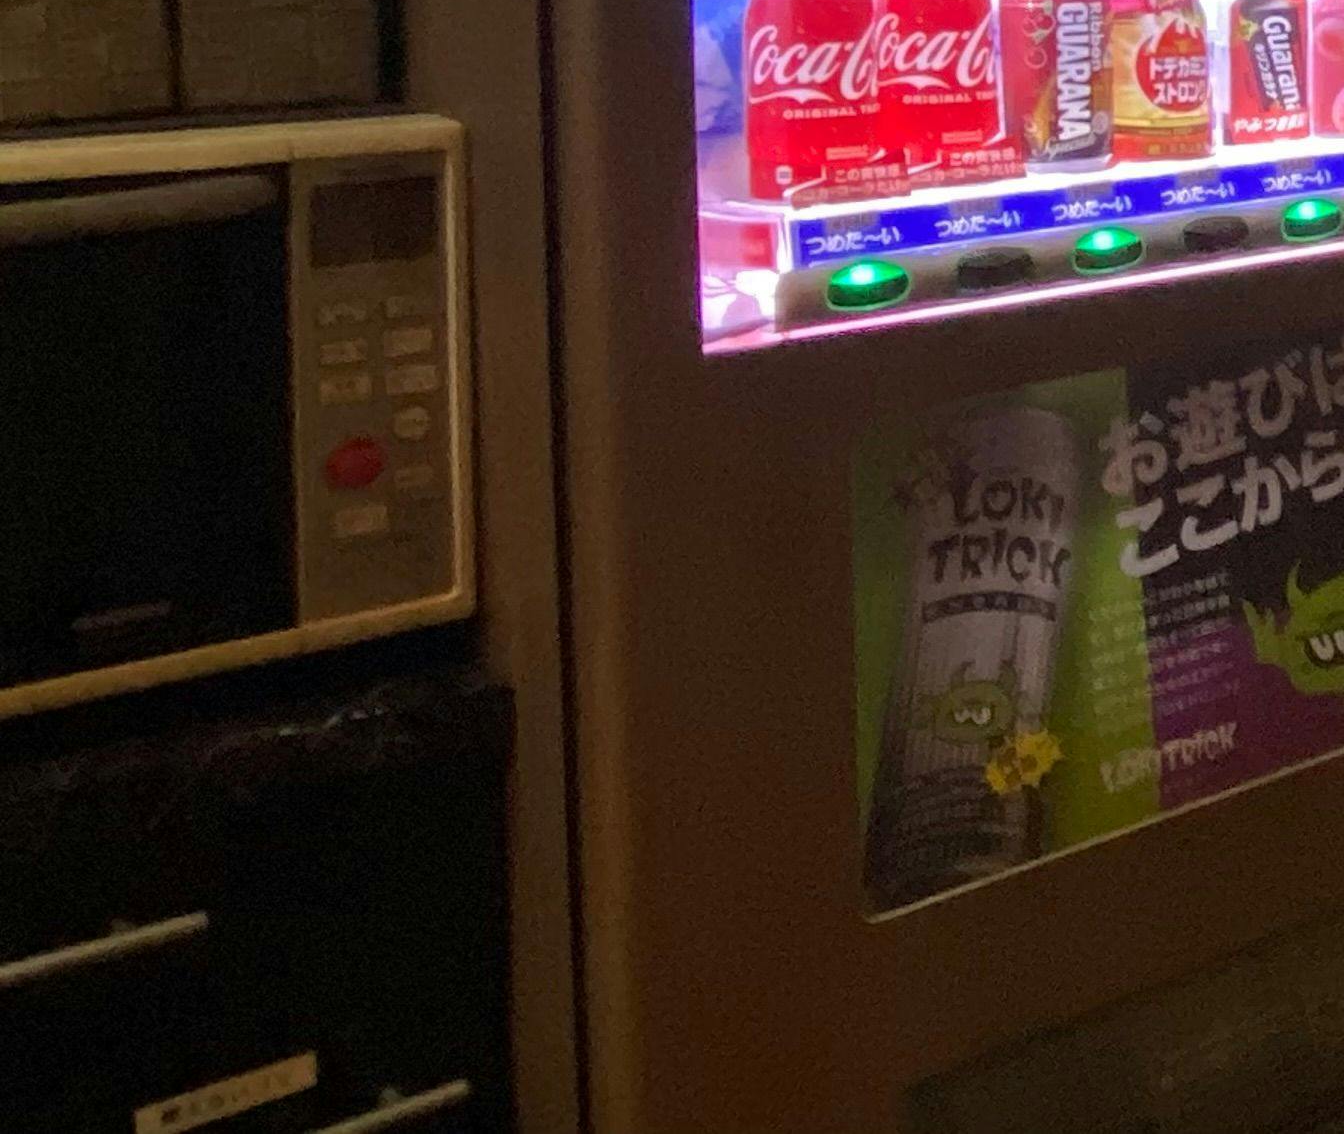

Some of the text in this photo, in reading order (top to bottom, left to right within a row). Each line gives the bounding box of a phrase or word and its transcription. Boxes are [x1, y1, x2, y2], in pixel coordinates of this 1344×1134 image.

[1056, 2, 1092, 140] GUARANA
[783, 105, 857, 120] ORIGINAL
[903, 91, 973, 105] ORIGINAL
[927, 530, 1071, 587] TRICK
